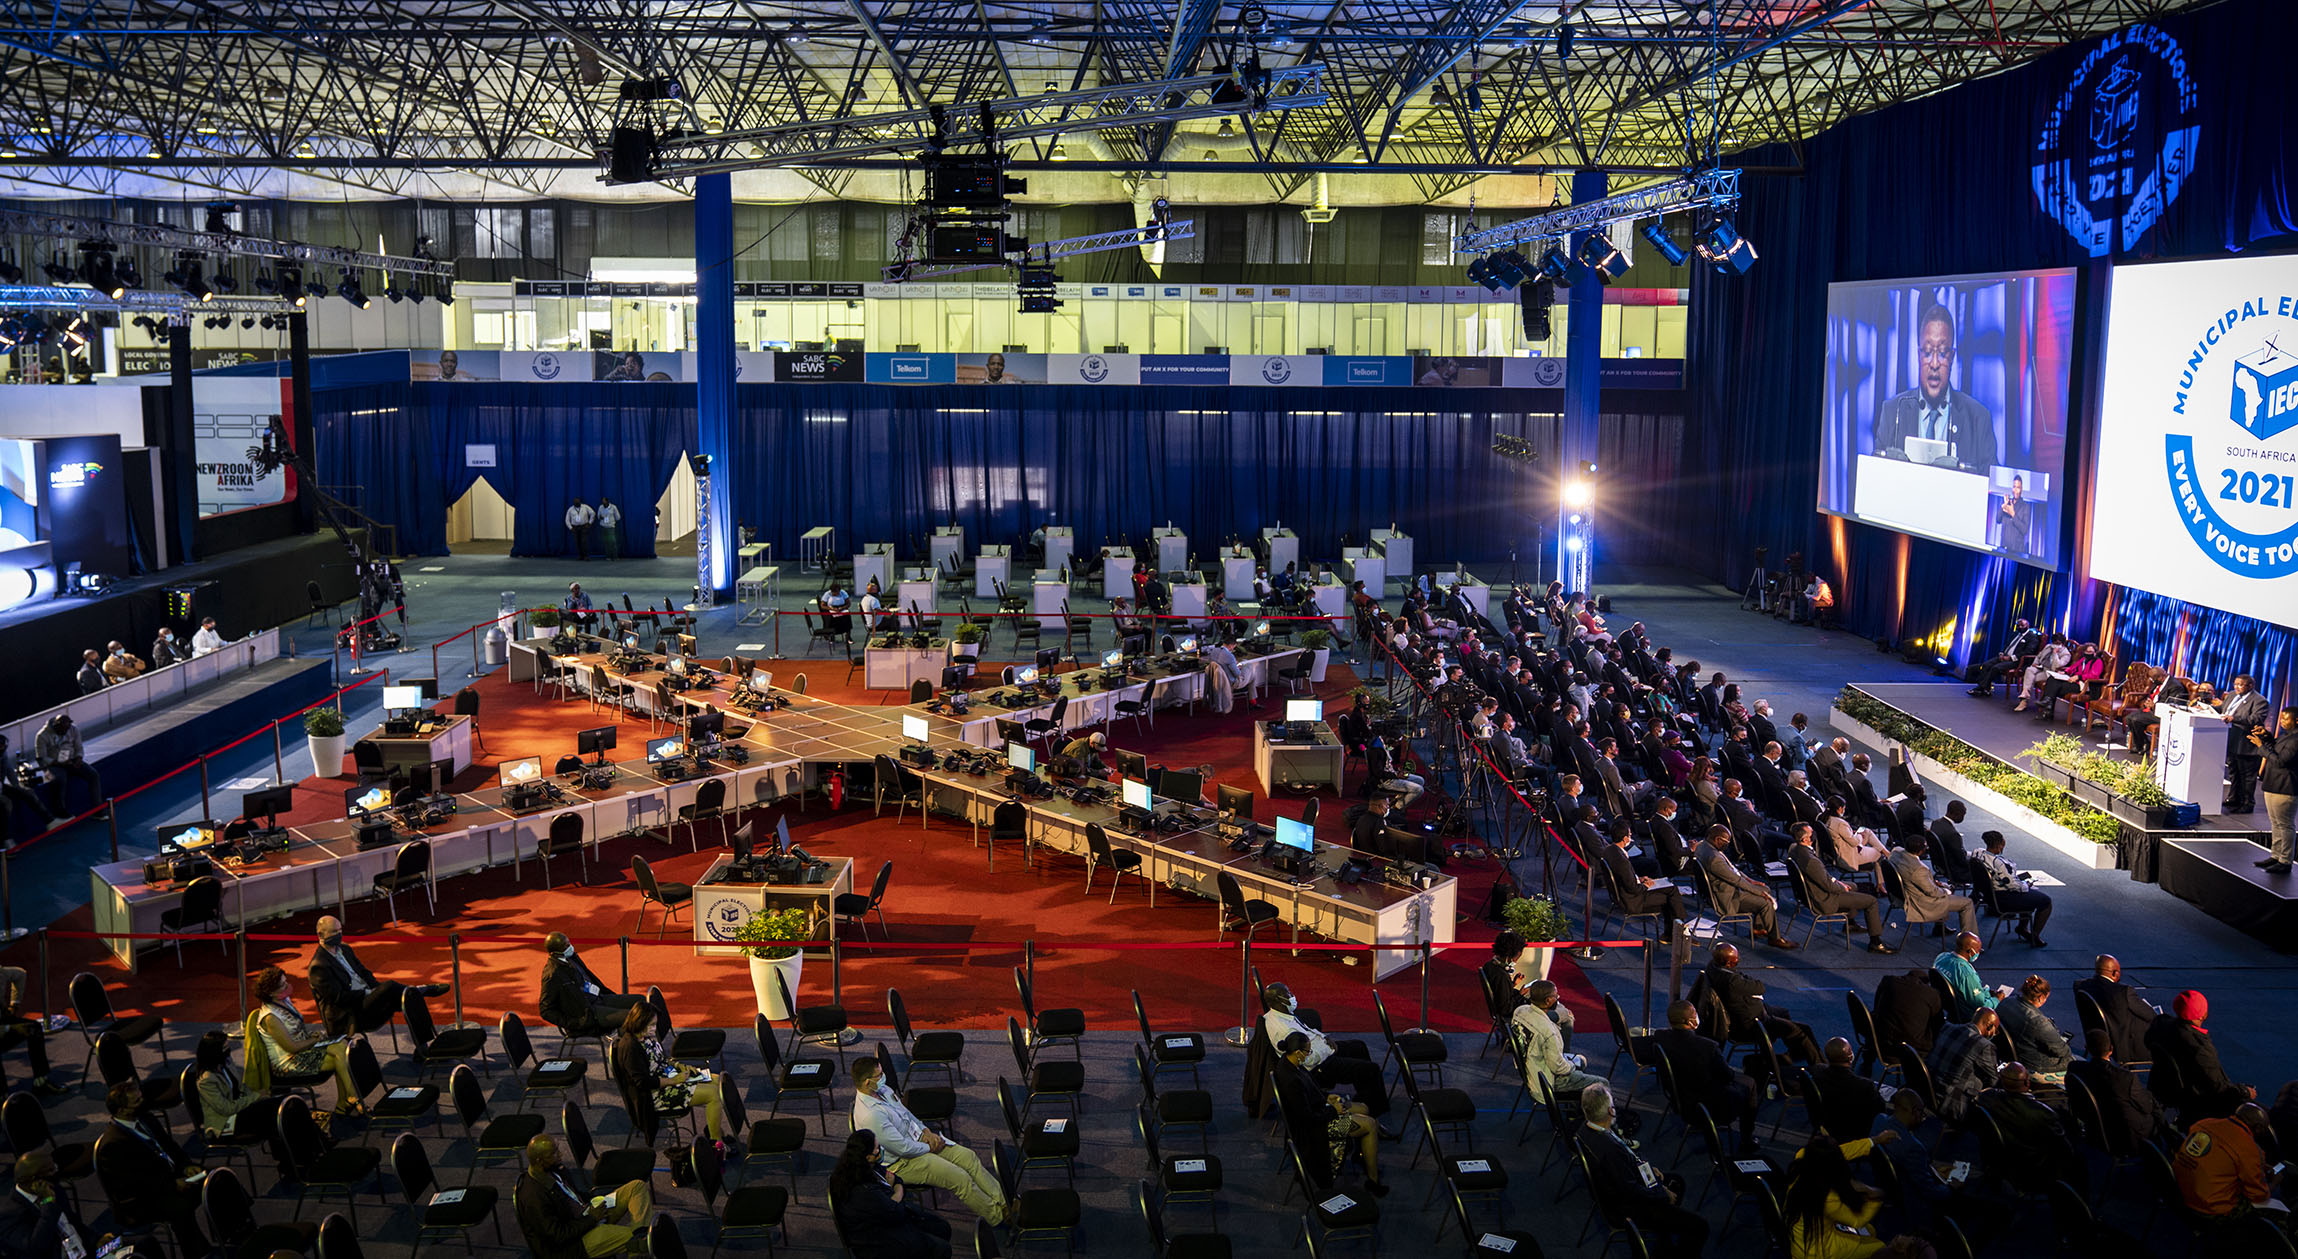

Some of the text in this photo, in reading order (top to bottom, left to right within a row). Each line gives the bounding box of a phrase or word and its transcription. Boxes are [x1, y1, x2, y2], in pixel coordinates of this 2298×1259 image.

[124, 351, 144, 359] LOCAL
[218, 352, 239, 360] SABC
[803, 354, 825, 362] SABC
[2172, 297, 2269, 415] MUNICIPAL
[791, 362, 825, 373] NEWS
[896, 364, 922, 373] Telkom
[1353, 367, 1378, 376] Telkom
[2267, 380, 2298, 419] IEC
[2226, 446, 2297, 463] SOUTH AFRICA
[196, 463, 253, 475] NEWZROOM
[217, 475, 254, 486] AFRIKA
[2219, 468, 2294, 509] 2021
[2172, 449, 2206, 524] EVERY
[2205, 521, 2260, 566] VOICE
[707, 899, 728, 918] MUNICIPAL
